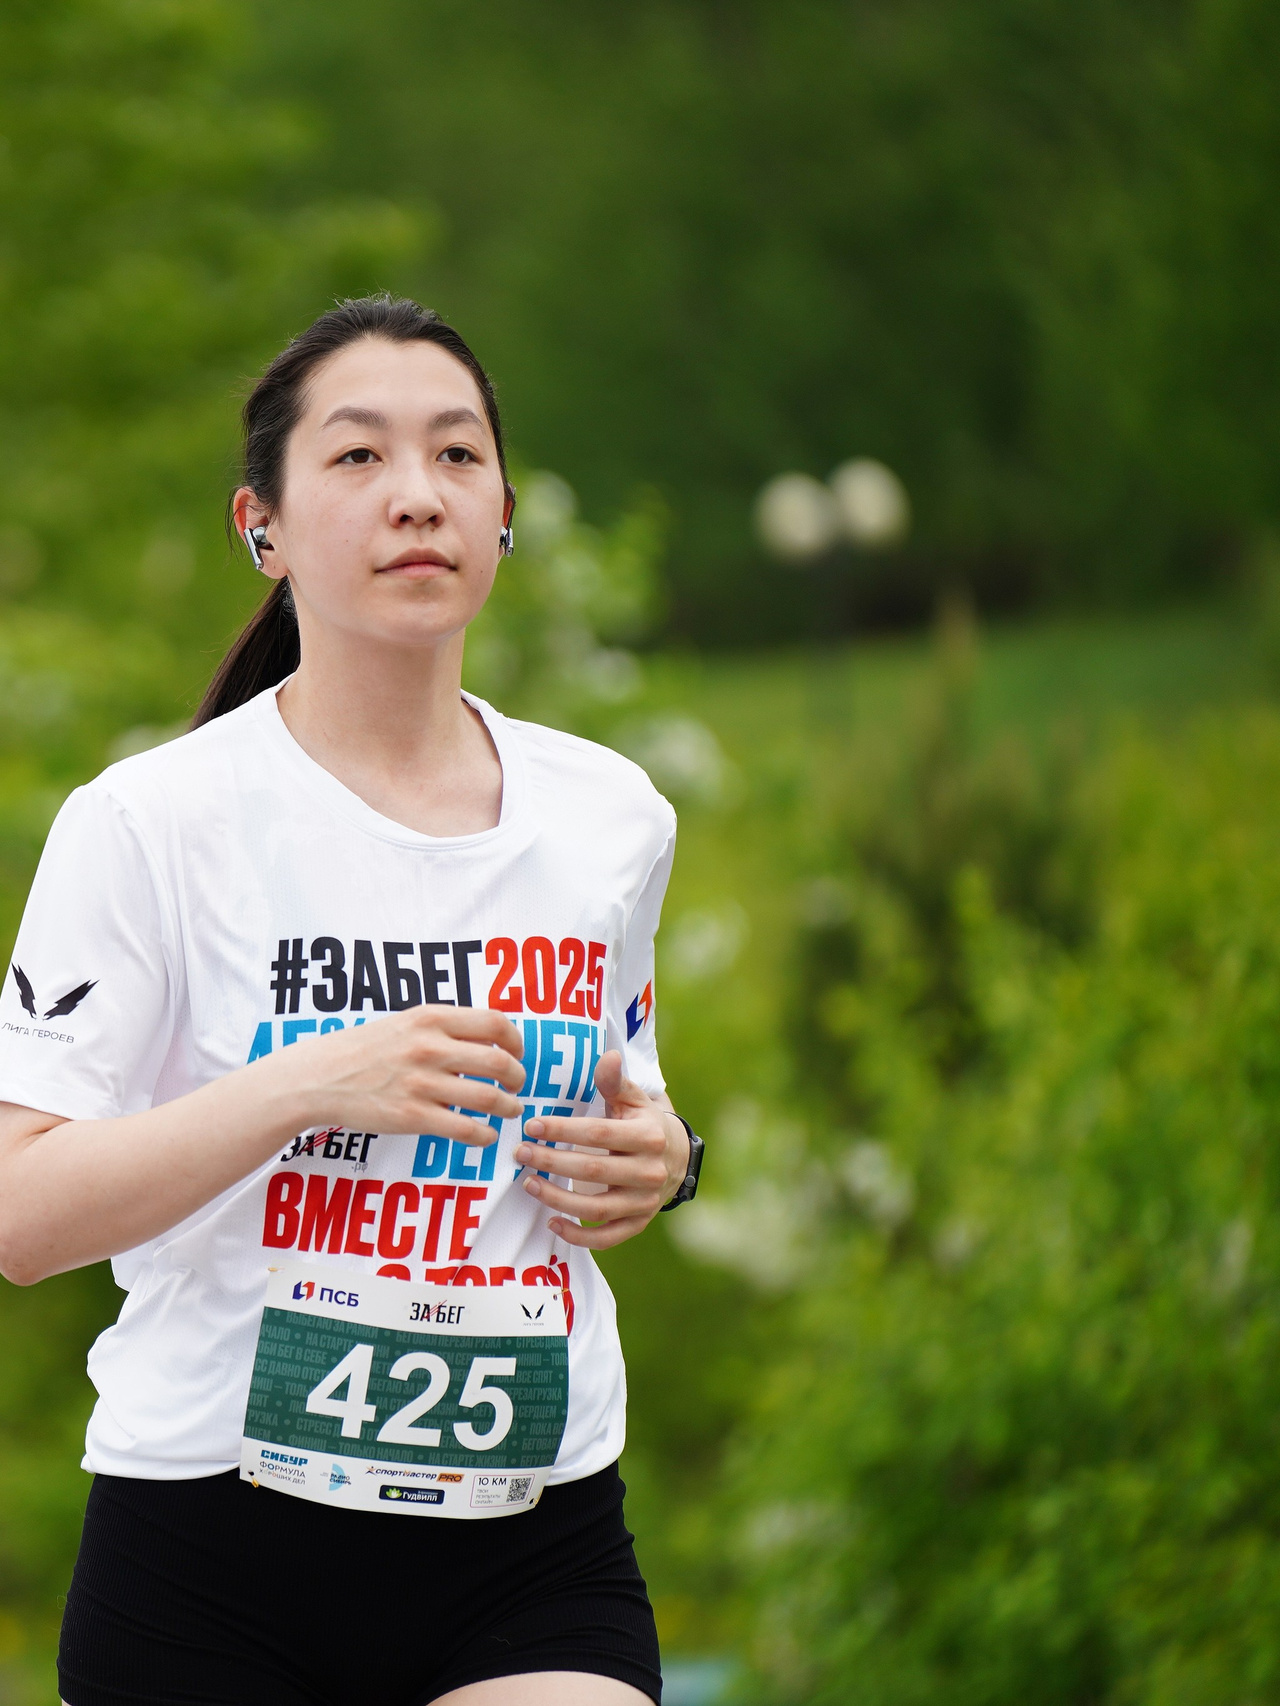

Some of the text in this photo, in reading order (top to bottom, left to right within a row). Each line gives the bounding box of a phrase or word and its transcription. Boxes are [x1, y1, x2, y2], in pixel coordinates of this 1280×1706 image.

[2, 1022, 75, 1044] ЛИГА ГЕРОЕВ
[262, 1172, 488, 1262] ВМЕСТЕ
[320, 1287, 359, 1307] ПСБ
[303, 1349, 328, 1365] СЕБЕ
[306, 1343, 517, 1451] 425
[261, 1449, 308, 1467] СИБУР
[260, 1461, 306, 1478] ФОРМУЛА
[439, 1473, 463, 1483] PRO
[478, 1477, 490, 1486] 10
